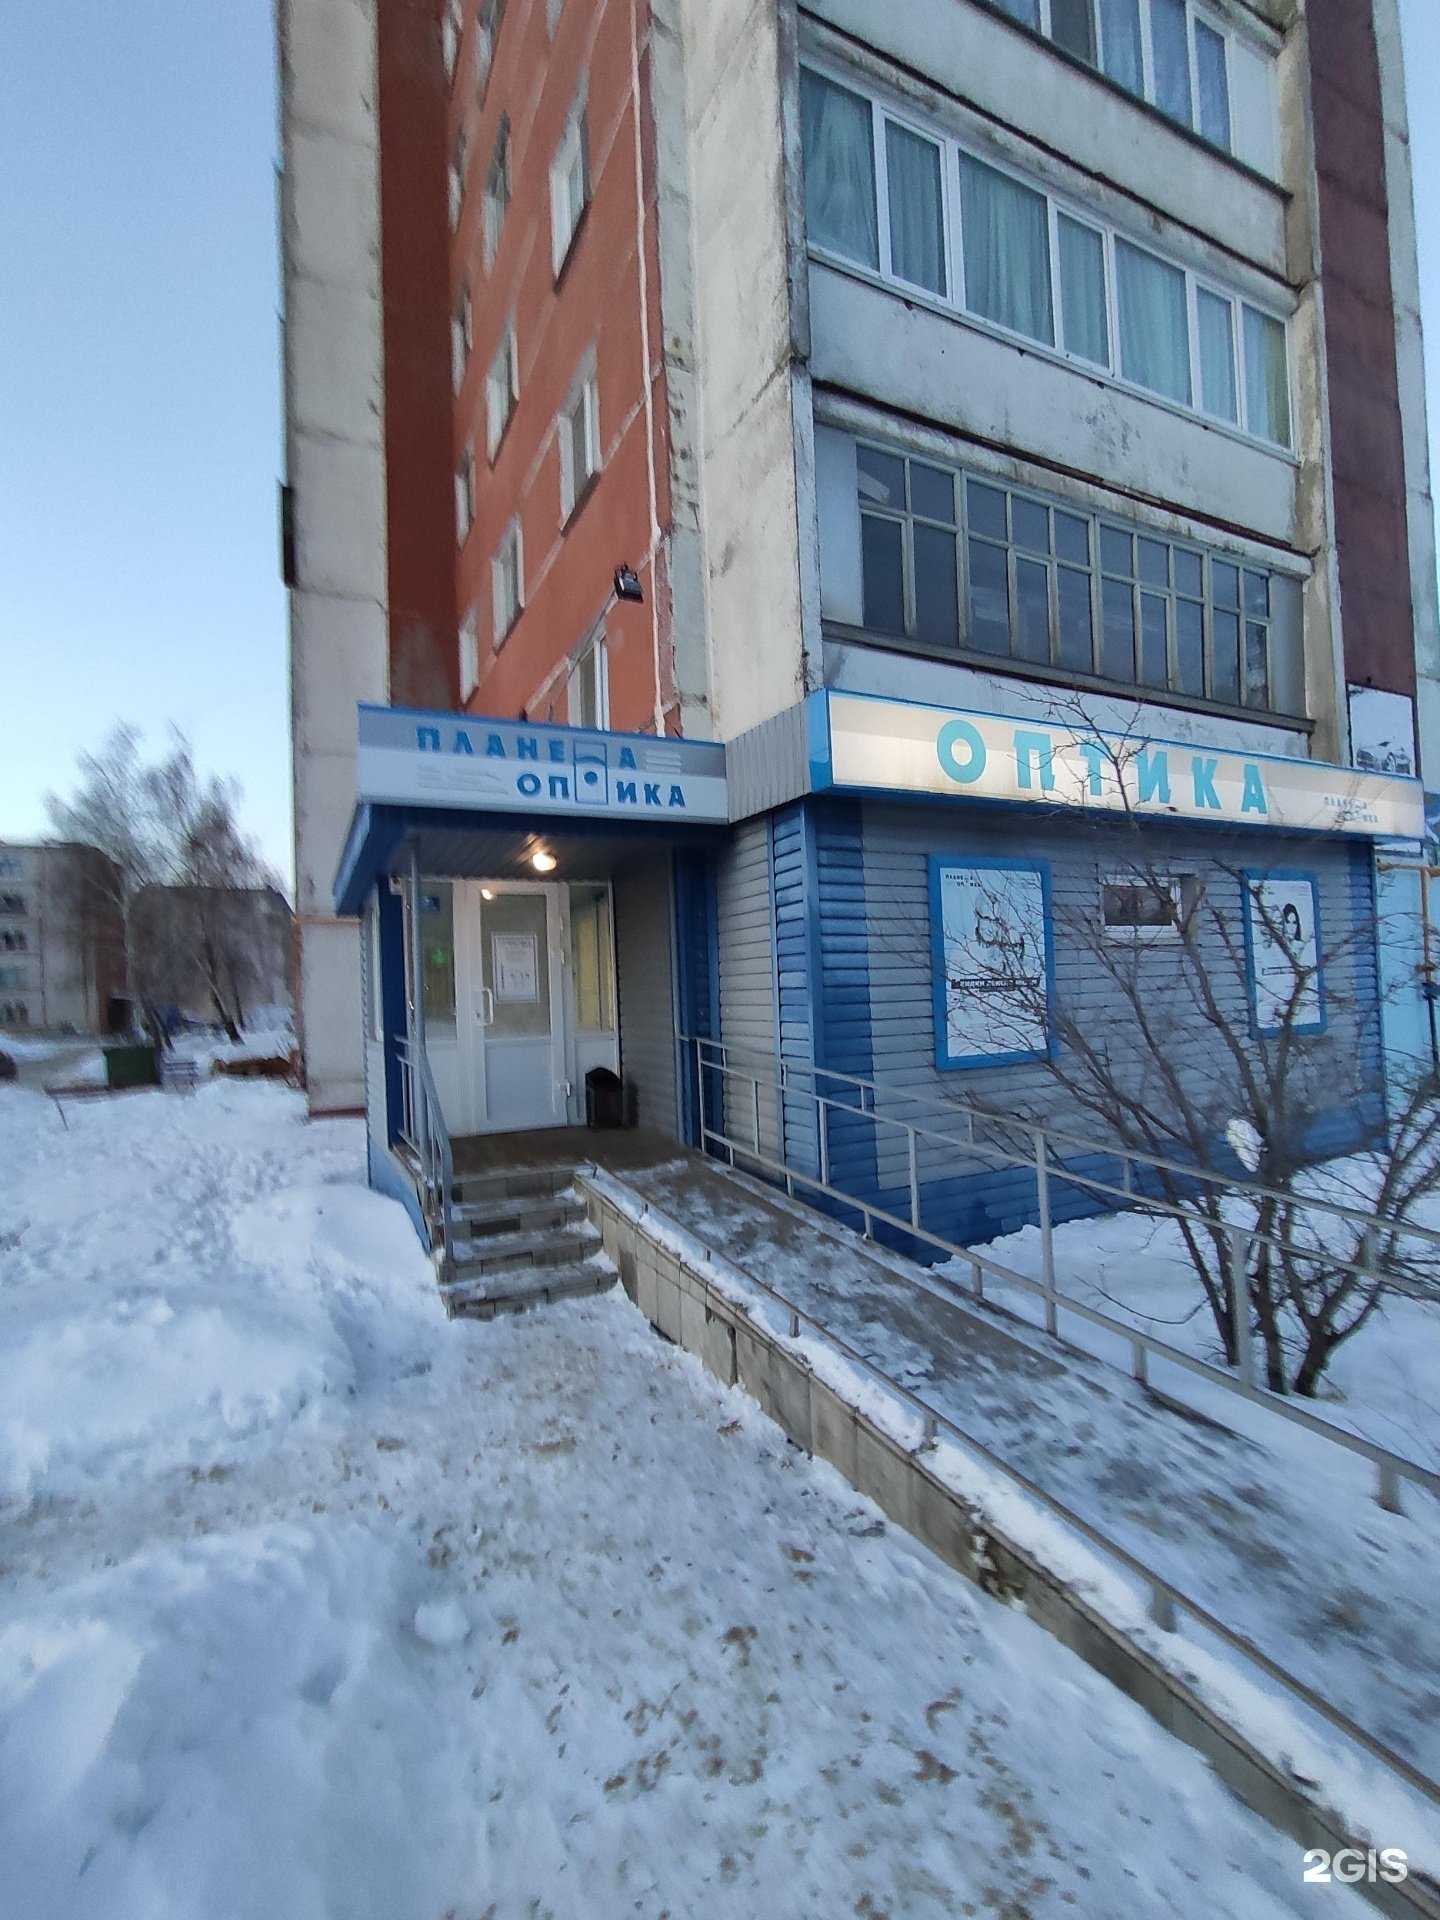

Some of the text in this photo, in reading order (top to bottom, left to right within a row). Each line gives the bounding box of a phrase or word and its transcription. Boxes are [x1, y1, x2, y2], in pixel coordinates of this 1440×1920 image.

[416, 727, 637, 769] ПЛАНЕА
[937, 719, 1267, 814] ОПТИКА
[517, 773, 686, 808] ОПИКА
